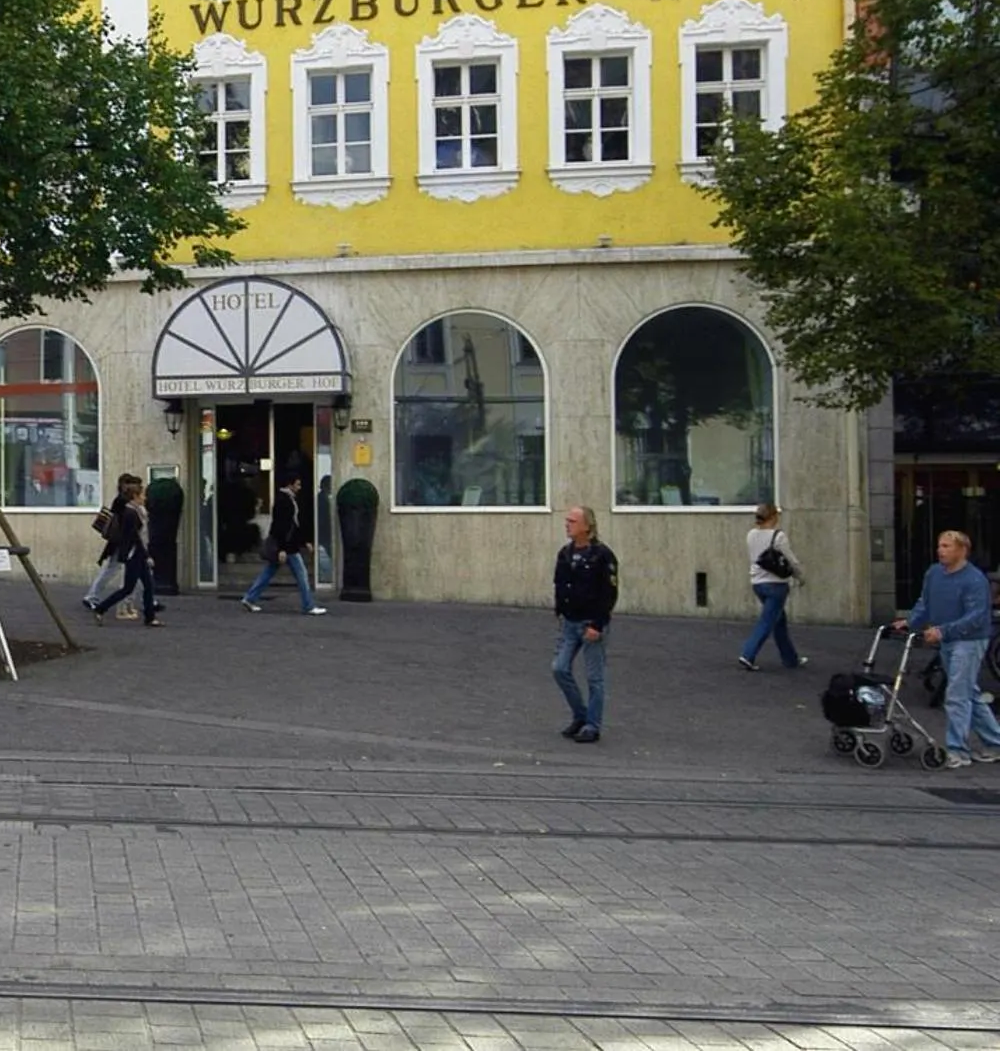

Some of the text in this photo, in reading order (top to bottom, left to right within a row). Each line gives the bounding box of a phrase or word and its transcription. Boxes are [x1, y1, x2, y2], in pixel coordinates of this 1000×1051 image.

[212, 292, 280, 311] HOTEL
[158, 379, 202, 392] HOTEL
[311, 376, 338, 389] HOF
